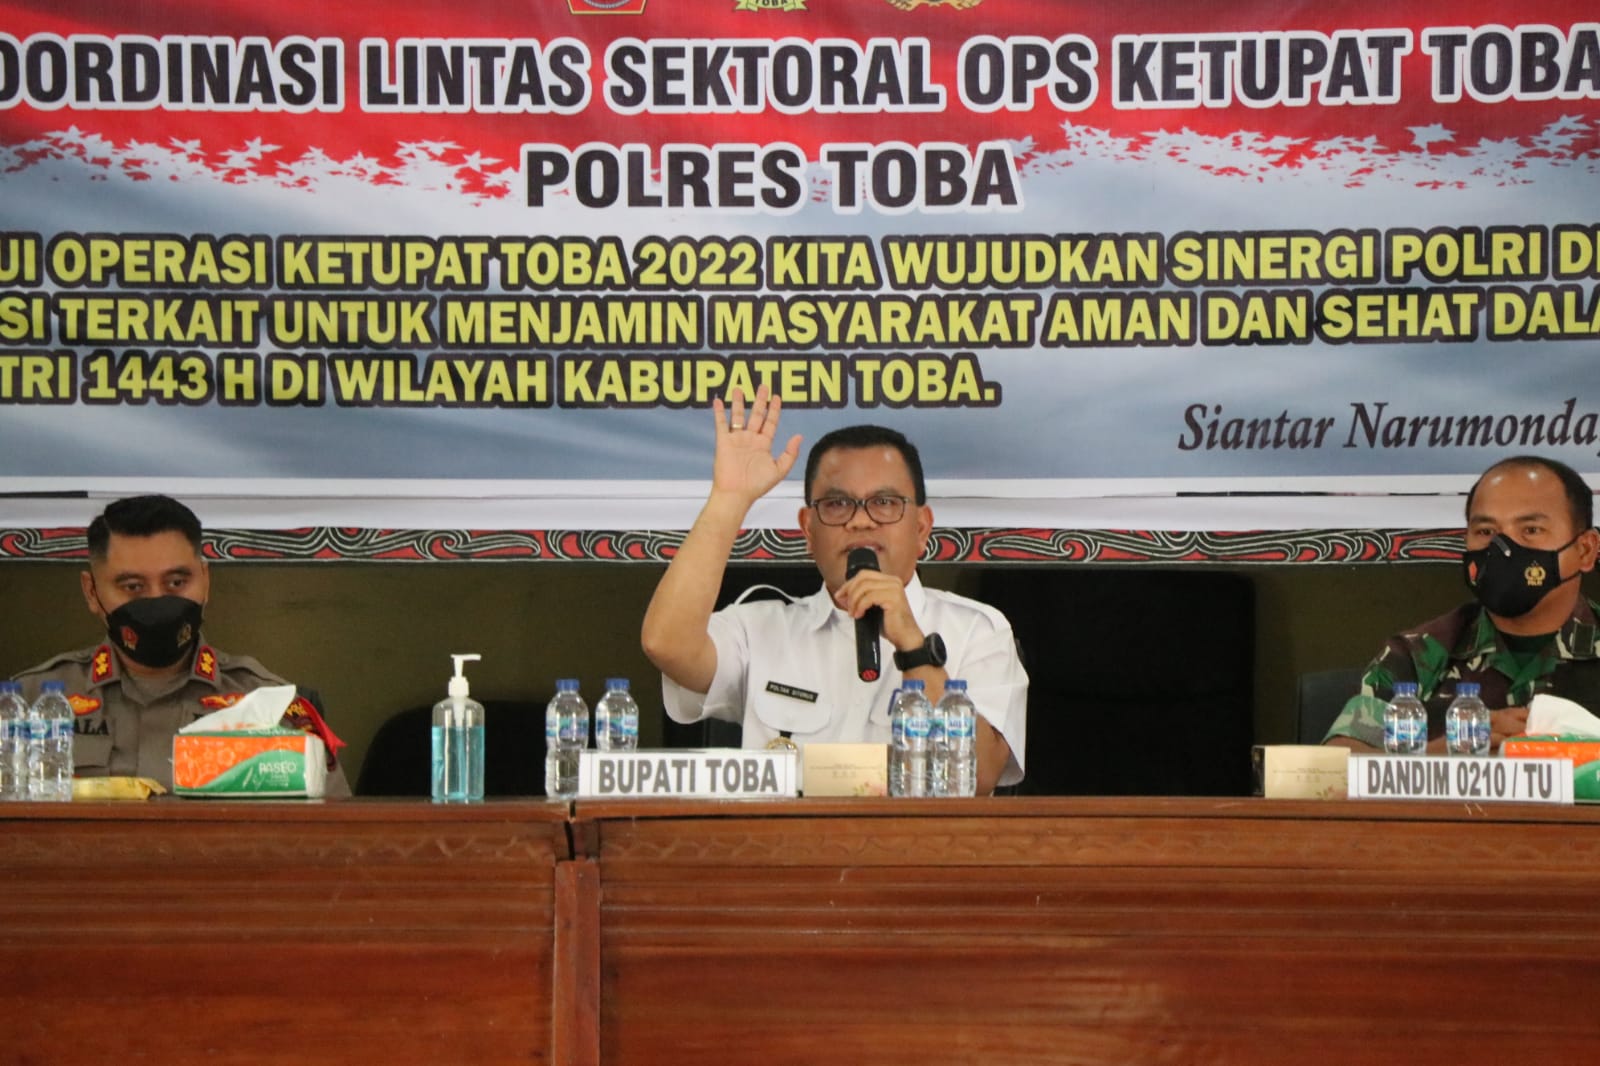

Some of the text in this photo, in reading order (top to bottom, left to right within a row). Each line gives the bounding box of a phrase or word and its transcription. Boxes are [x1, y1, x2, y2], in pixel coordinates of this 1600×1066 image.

[367, 46, 584, 106] LINTAS
[612, 46, 939, 106] SEKTORAL
[966, 43, 1090, 104] OPS
[1120, 37, 1405, 100] KETUPAT
[1429, 31, 1600, 94] TOBA
[528, 150, 1016, 207] POLRES TOBA
[53, 240, 266, 283] OPERASI
[284, 242, 488, 284] KETUPAT
[501, 243, 625, 284] TOBA
[640, 242, 756, 284] 2022
[774, 243, 875, 284] KITA
[889, 240, 1157, 283] WUJUDKAN
[1173, 236, 1373, 280] SINERGI
[1393, 233, 1540, 276] POLRI
[1560, 232, 1600, 273] D
[0, 298, 43, 338] SI
[60, 299, 258, 341] TERKAIT
[275, 301, 431, 343] UNTUK
[447, 302, 697, 343] MENJAMIN
[715, 300, 1035, 343] MASYARAKAT
[1048, 298, 1189, 341] AMAN
[1208, 297, 1306, 339] DAN
[1323, 294, 1478, 337] SEHAT
[0, 357, 994, 402] TRI 1443 H DI WILAYAH KABUPATEN TOBA.
[1178, 404, 1335, 450] Siantar
[599, 759, 777, 793] BUPATI TOBA
[1368, 760, 1552, 799] DANDIM 0210 / TU
